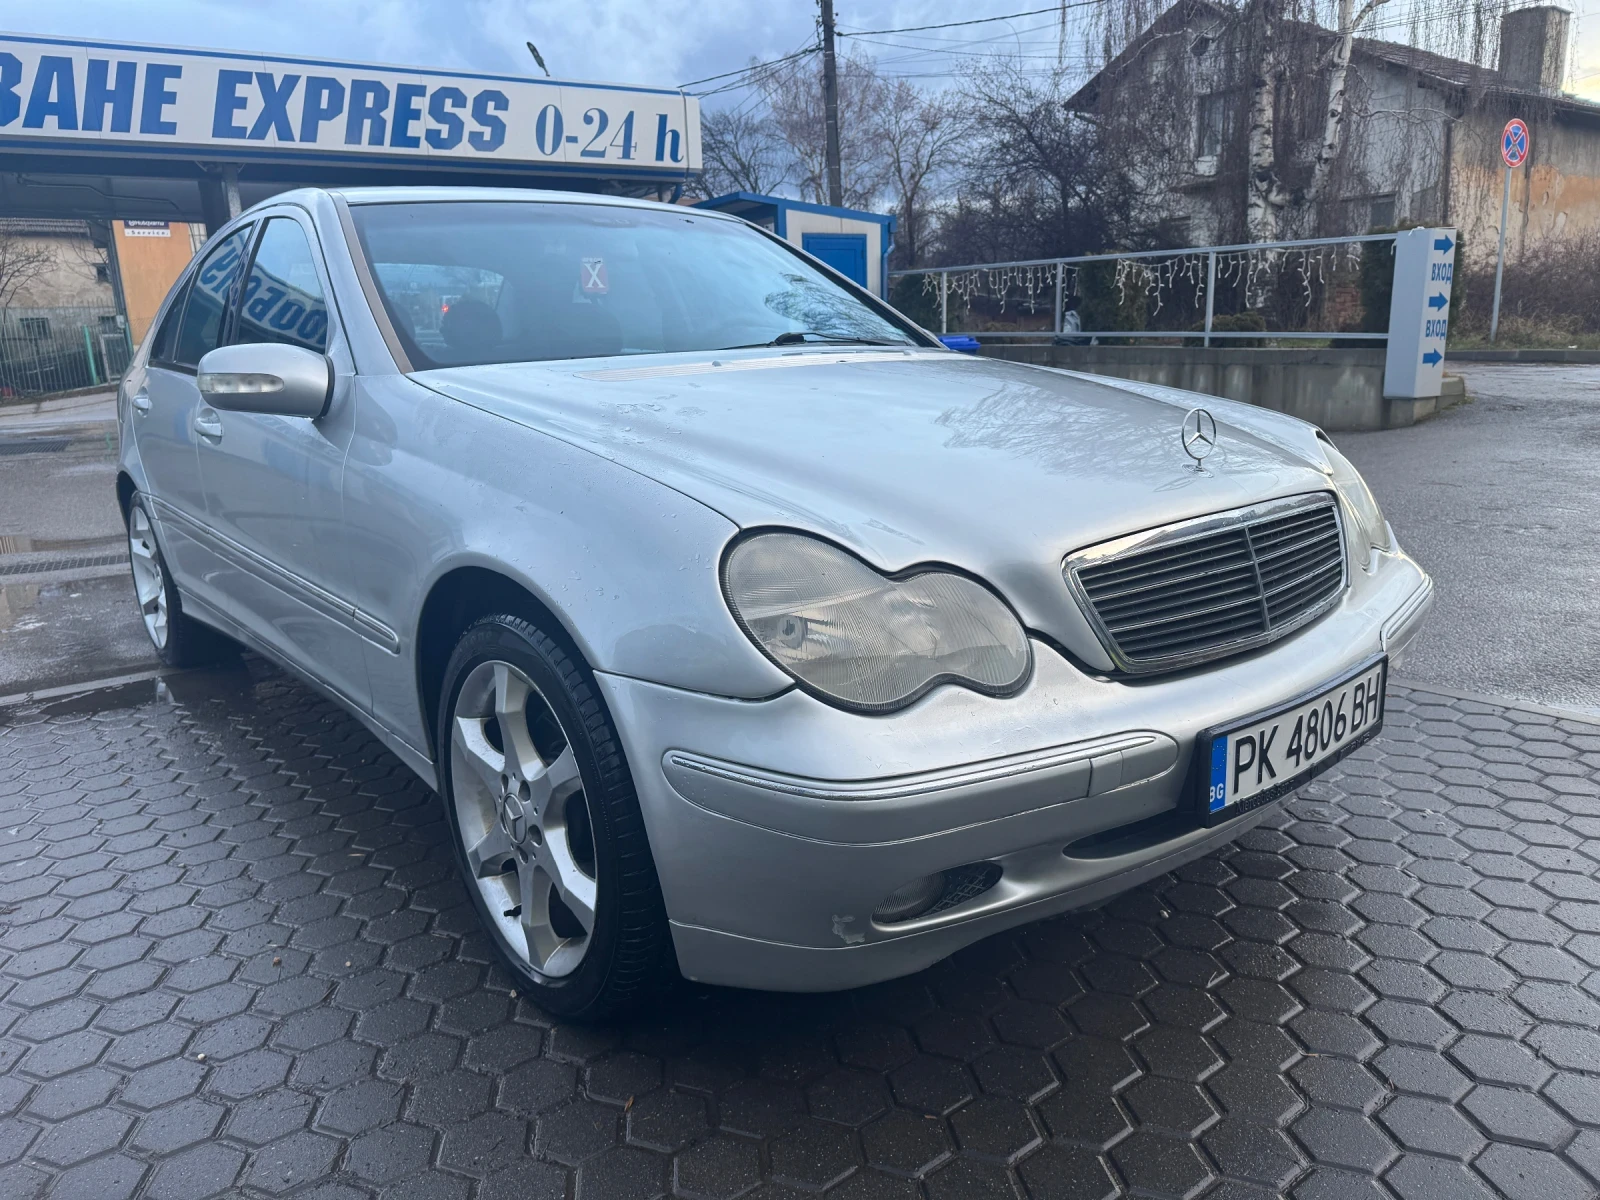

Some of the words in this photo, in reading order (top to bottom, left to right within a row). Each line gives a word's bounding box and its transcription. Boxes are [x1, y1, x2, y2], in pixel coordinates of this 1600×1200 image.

[211, 69, 510, 152] EXPRESS
[535, 104, 638, 160] 0-24
[655, 113, 685, 163] h
[1431, 262, 1453, 284] ВХОД
[1425, 319, 1447, 340] ВХОД
[1233, 724, 1279, 794] PK
[1286, 691, 1347, 768] 4806
[1351, 672, 1381, 733] BH
[1209, 783, 1224, 802] BG
